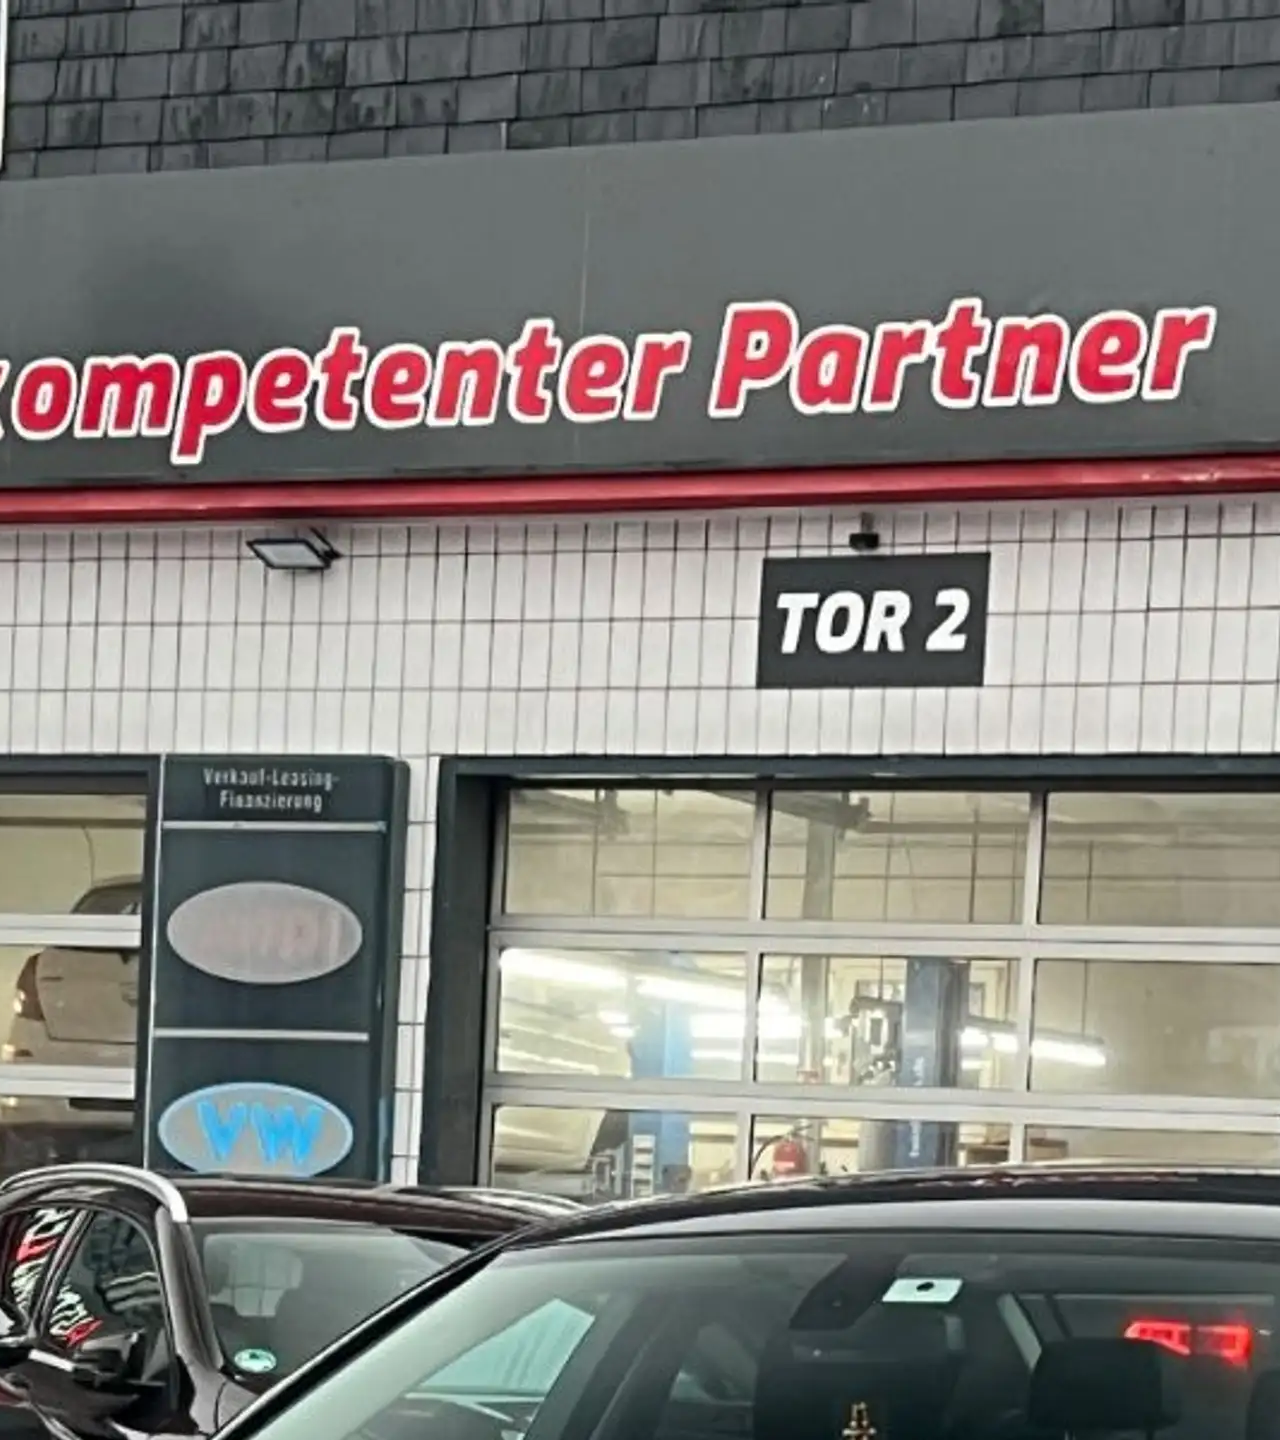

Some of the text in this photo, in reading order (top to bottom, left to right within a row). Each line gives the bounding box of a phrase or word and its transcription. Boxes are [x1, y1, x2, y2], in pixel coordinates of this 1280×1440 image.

[708, 297, 1217, 419] Partner
[776, 588, 970, 654] TOR 2
[219, 790, 323, 813] Finanzierung
[197, 1100, 325, 1166] VW
